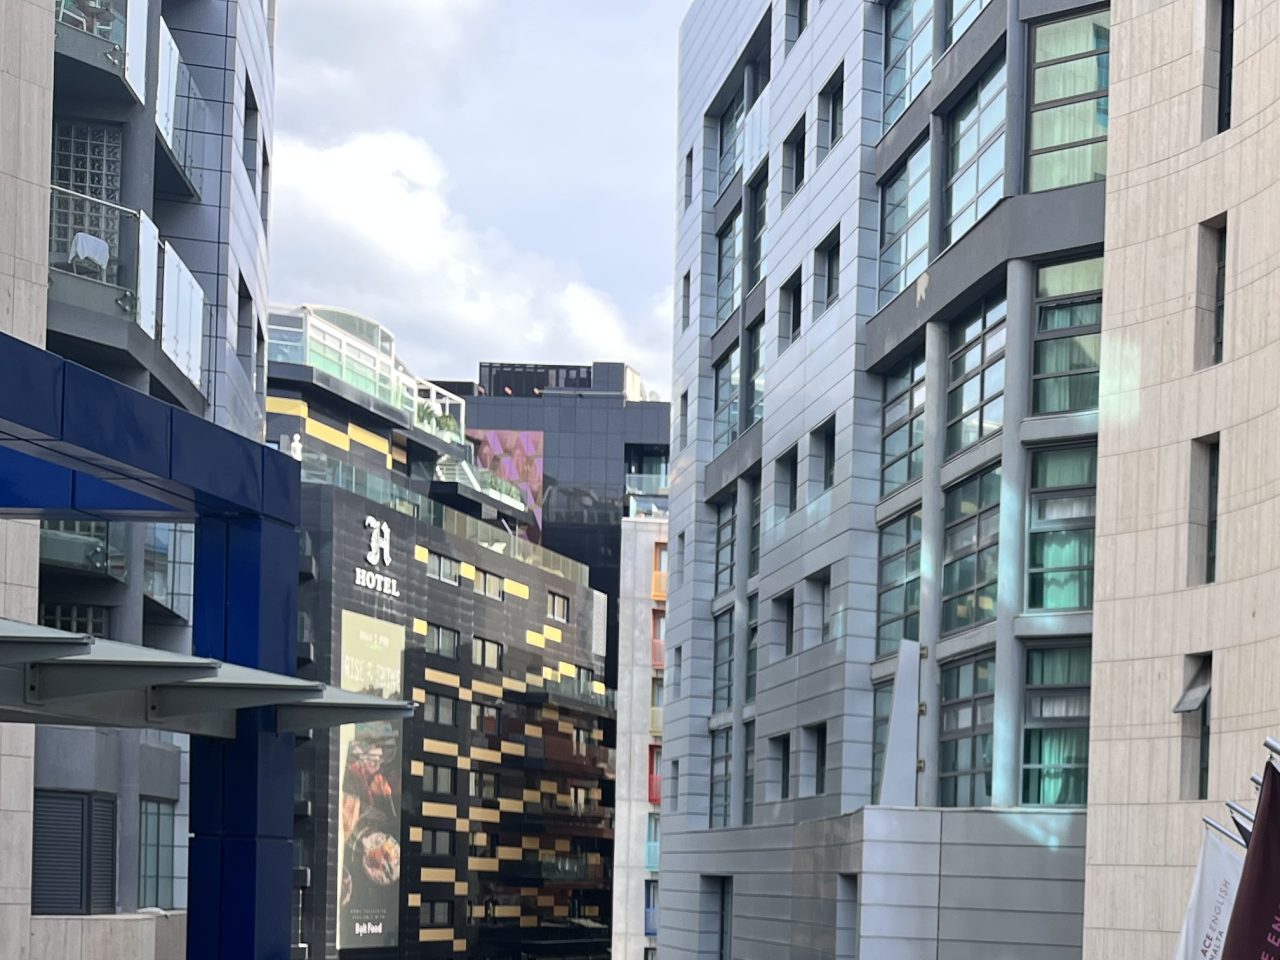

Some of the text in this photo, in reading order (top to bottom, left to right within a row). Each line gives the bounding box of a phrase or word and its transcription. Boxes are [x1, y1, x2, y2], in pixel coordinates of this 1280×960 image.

[354, 566, 401, 598] HOTEL
[1200, 879, 1231, 958] ACE ENGLISH
